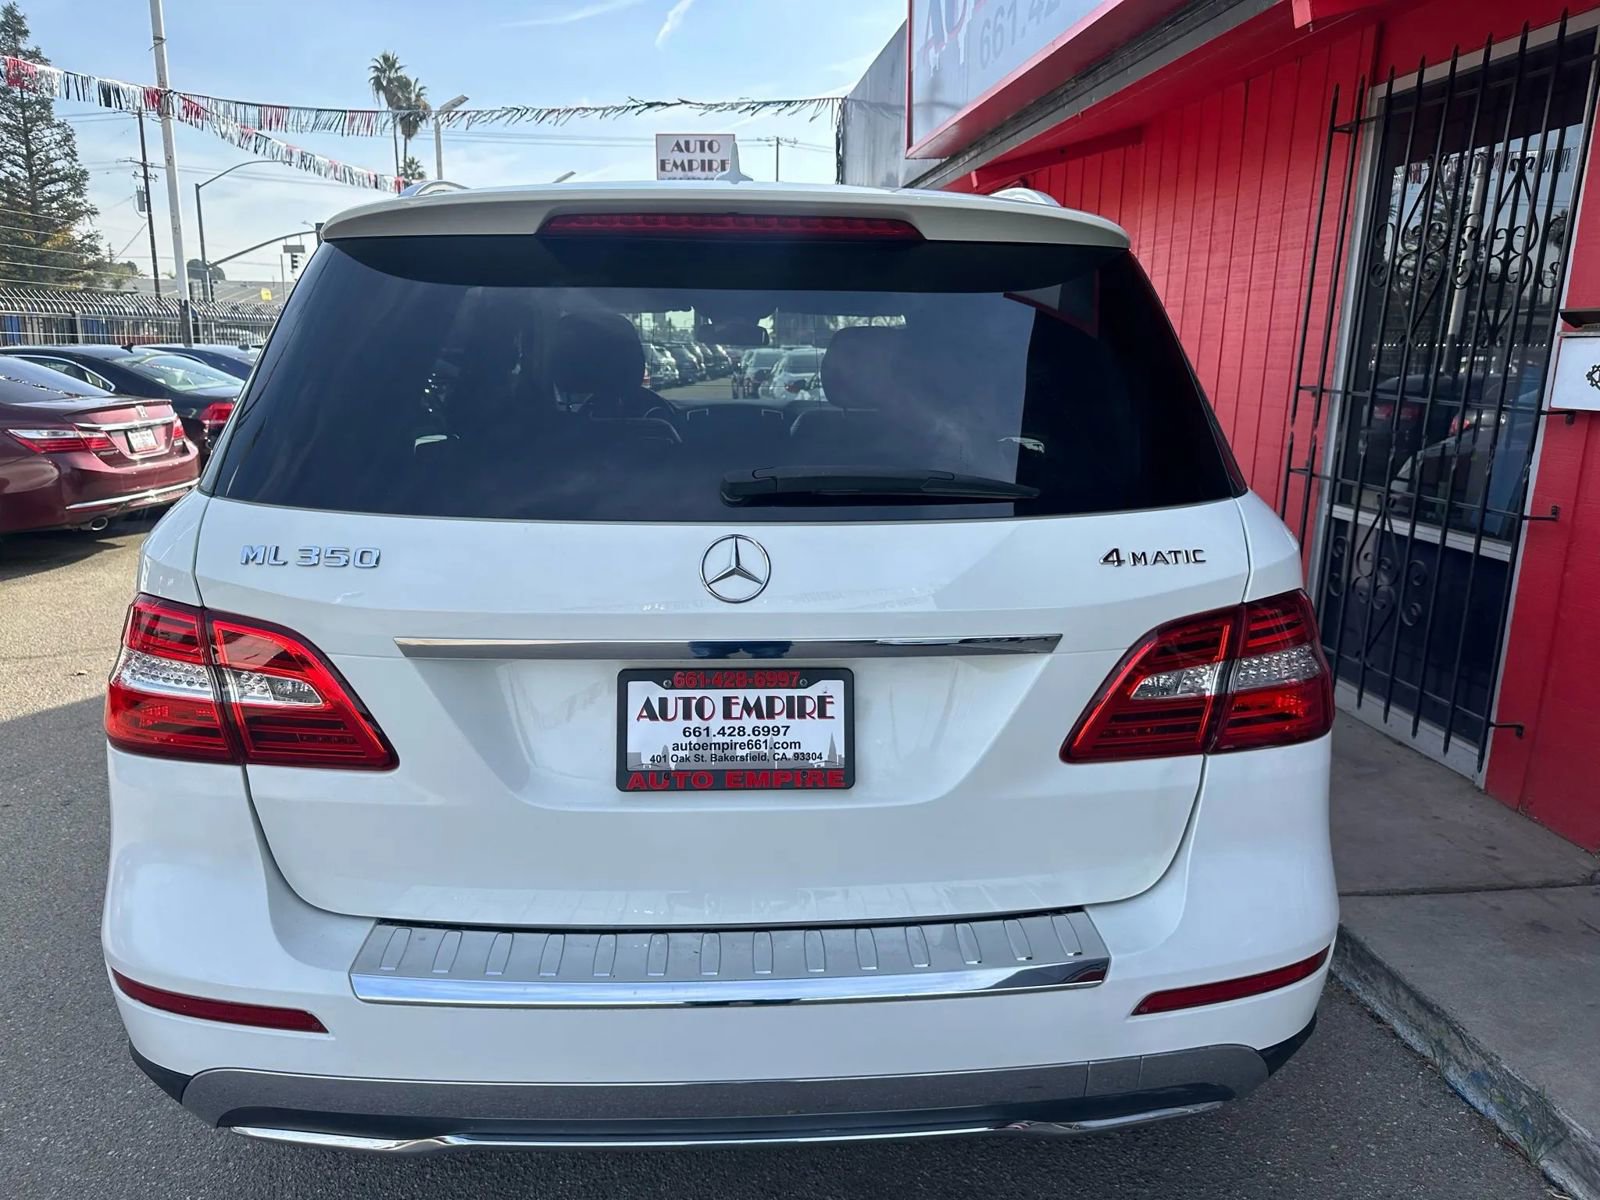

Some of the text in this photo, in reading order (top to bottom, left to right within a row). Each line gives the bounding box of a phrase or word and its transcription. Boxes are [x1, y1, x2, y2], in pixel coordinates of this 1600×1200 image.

[671, 139, 721, 154] AUTO
[240, 545, 380, 569] ML 350
[672, 671, 801, 688] 661-428-6997
[636, 695, 835, 721] AUTO EMPIRE
[682, 725, 791, 738] 661.428.6997
[672, 739, 801, 753] autoempire661.com
[649, 752, 823, 763] 401 Oak St. Bakersfield, CA. 93304
[627, 770, 846, 789] AUTO EMPIRE
